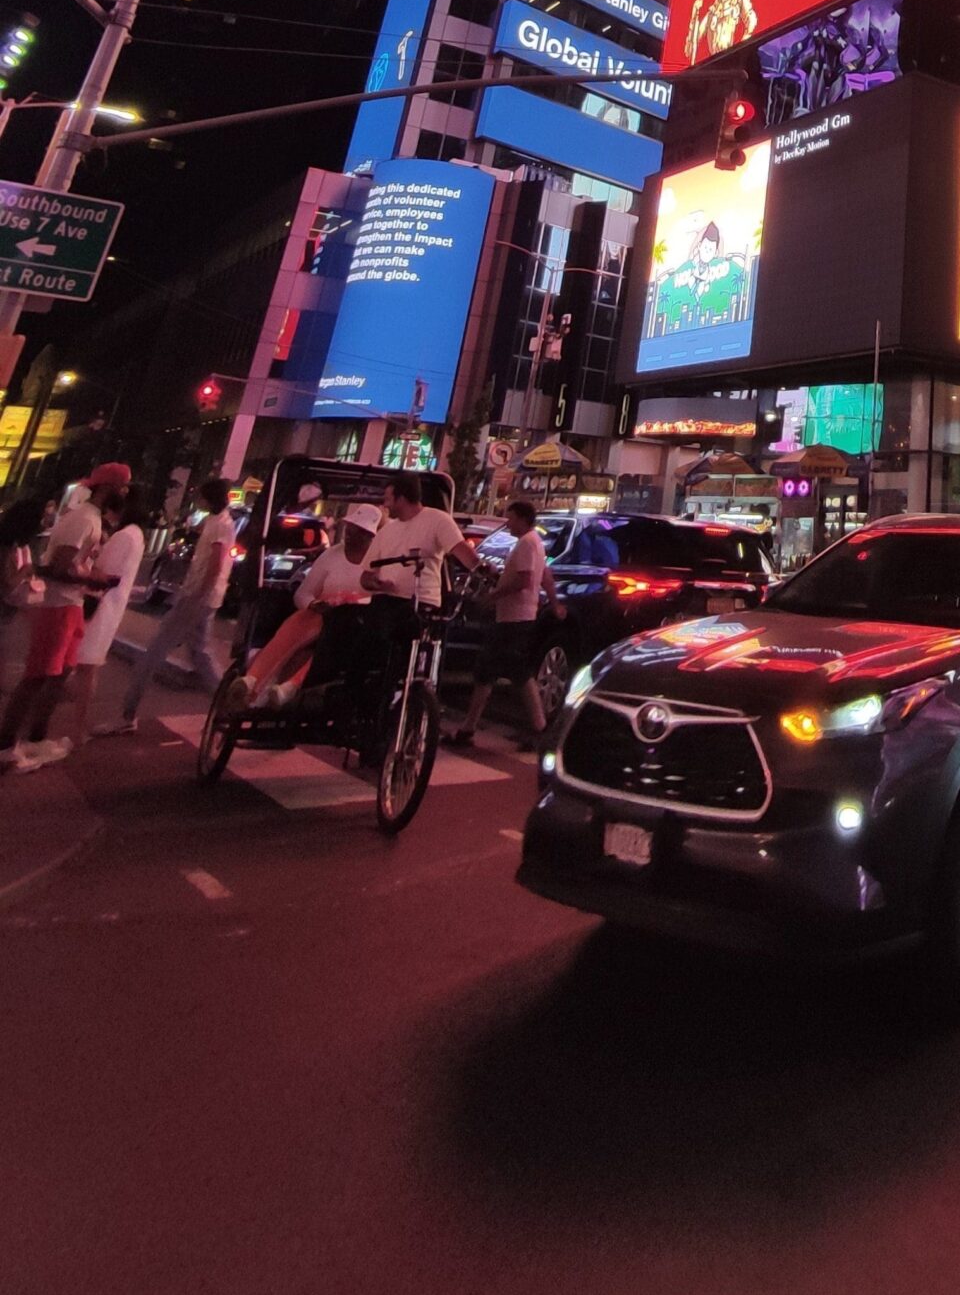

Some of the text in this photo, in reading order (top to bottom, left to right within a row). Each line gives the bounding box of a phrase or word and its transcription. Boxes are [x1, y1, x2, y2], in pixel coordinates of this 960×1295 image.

[652, 12, 670, 31] Gi
[518, 20, 600, 75] Global
[776, 114, 850, 149] Hollywood Gm
[387, 183, 404, 193] this
[407, 183, 461, 198] dedicated
[0, 188, 108, 223] Southbound
[383, 195, 393, 205] of
[394, 195, 445, 208] volunteer
[386, 208, 443, 221] employees
[0, 209, 88, 240] Use 7 Ave
[374, 220, 414, 232] together
[417, 220, 428, 231] to
[394, 232, 411, 242] the
[414, 233, 453, 247] impact
[374, 245, 392, 254] can
[394, 244, 425, 256] make
[360, 256, 409, 268] nonprofits
[18, 268, 76, 291] Route
[367, 269, 382, 280] the
[384, 269, 420, 282] globe.
[335, 375, 366, 388] Stanley
[555, 384, 569, 429] 5
[617, 393, 630, 435] 8
